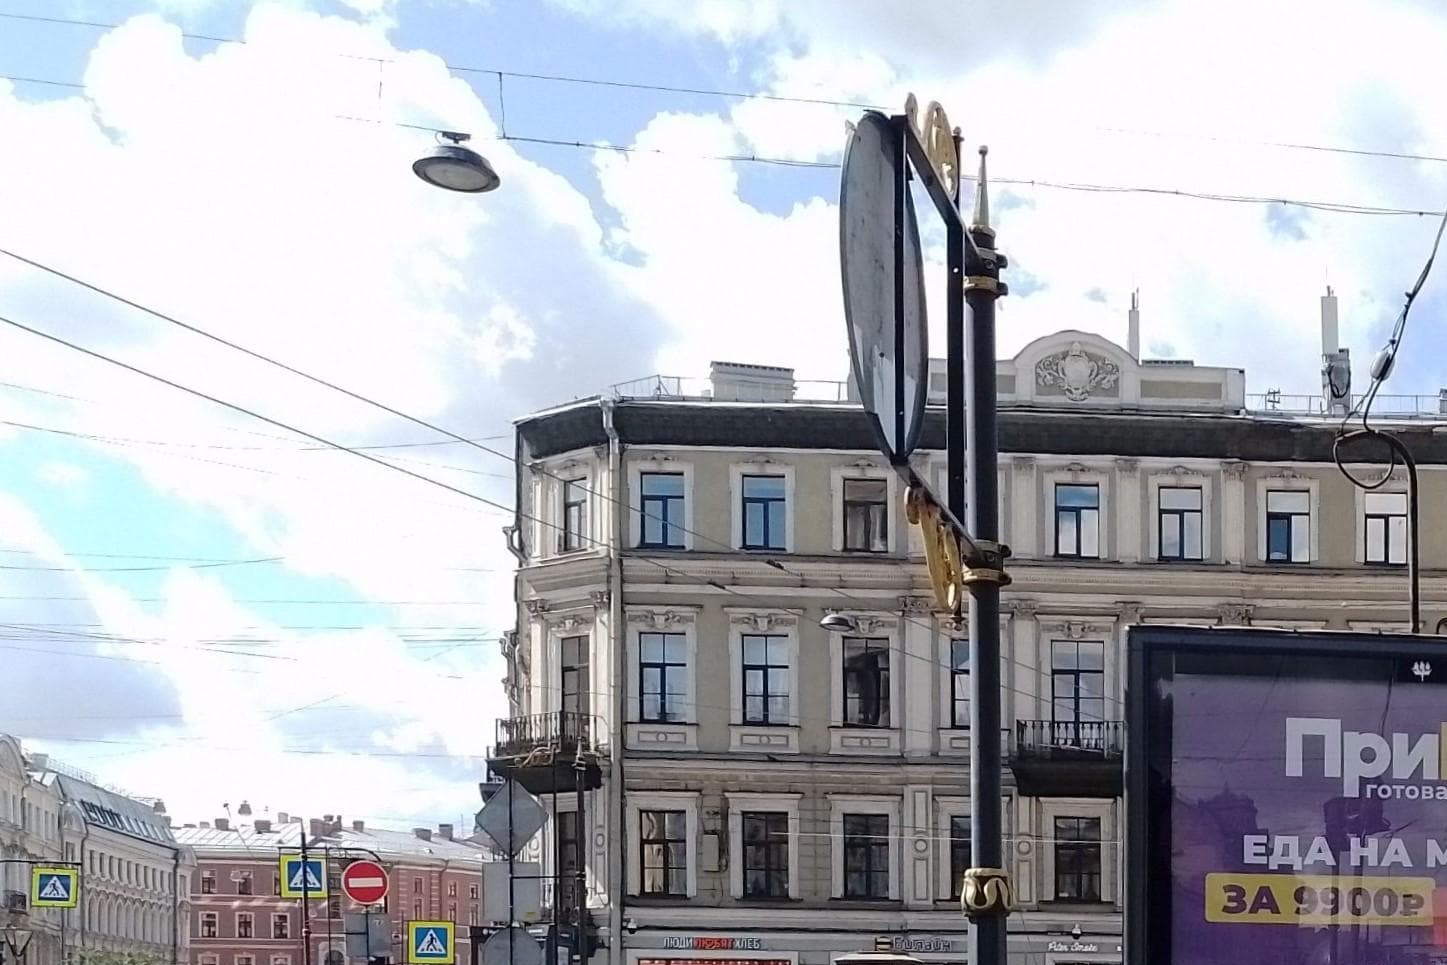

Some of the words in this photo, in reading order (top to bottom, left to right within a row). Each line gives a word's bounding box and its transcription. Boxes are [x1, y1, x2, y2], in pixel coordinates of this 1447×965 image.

[1243, 835, 1336, 870] ЕДА
[1350, 838, 1413, 867] НА
[1222, 884, 1281, 915] ЗА
[663, 937, 692, 949] ЛЮДИ
[734, 938, 760, 949] ХЛЕБ
